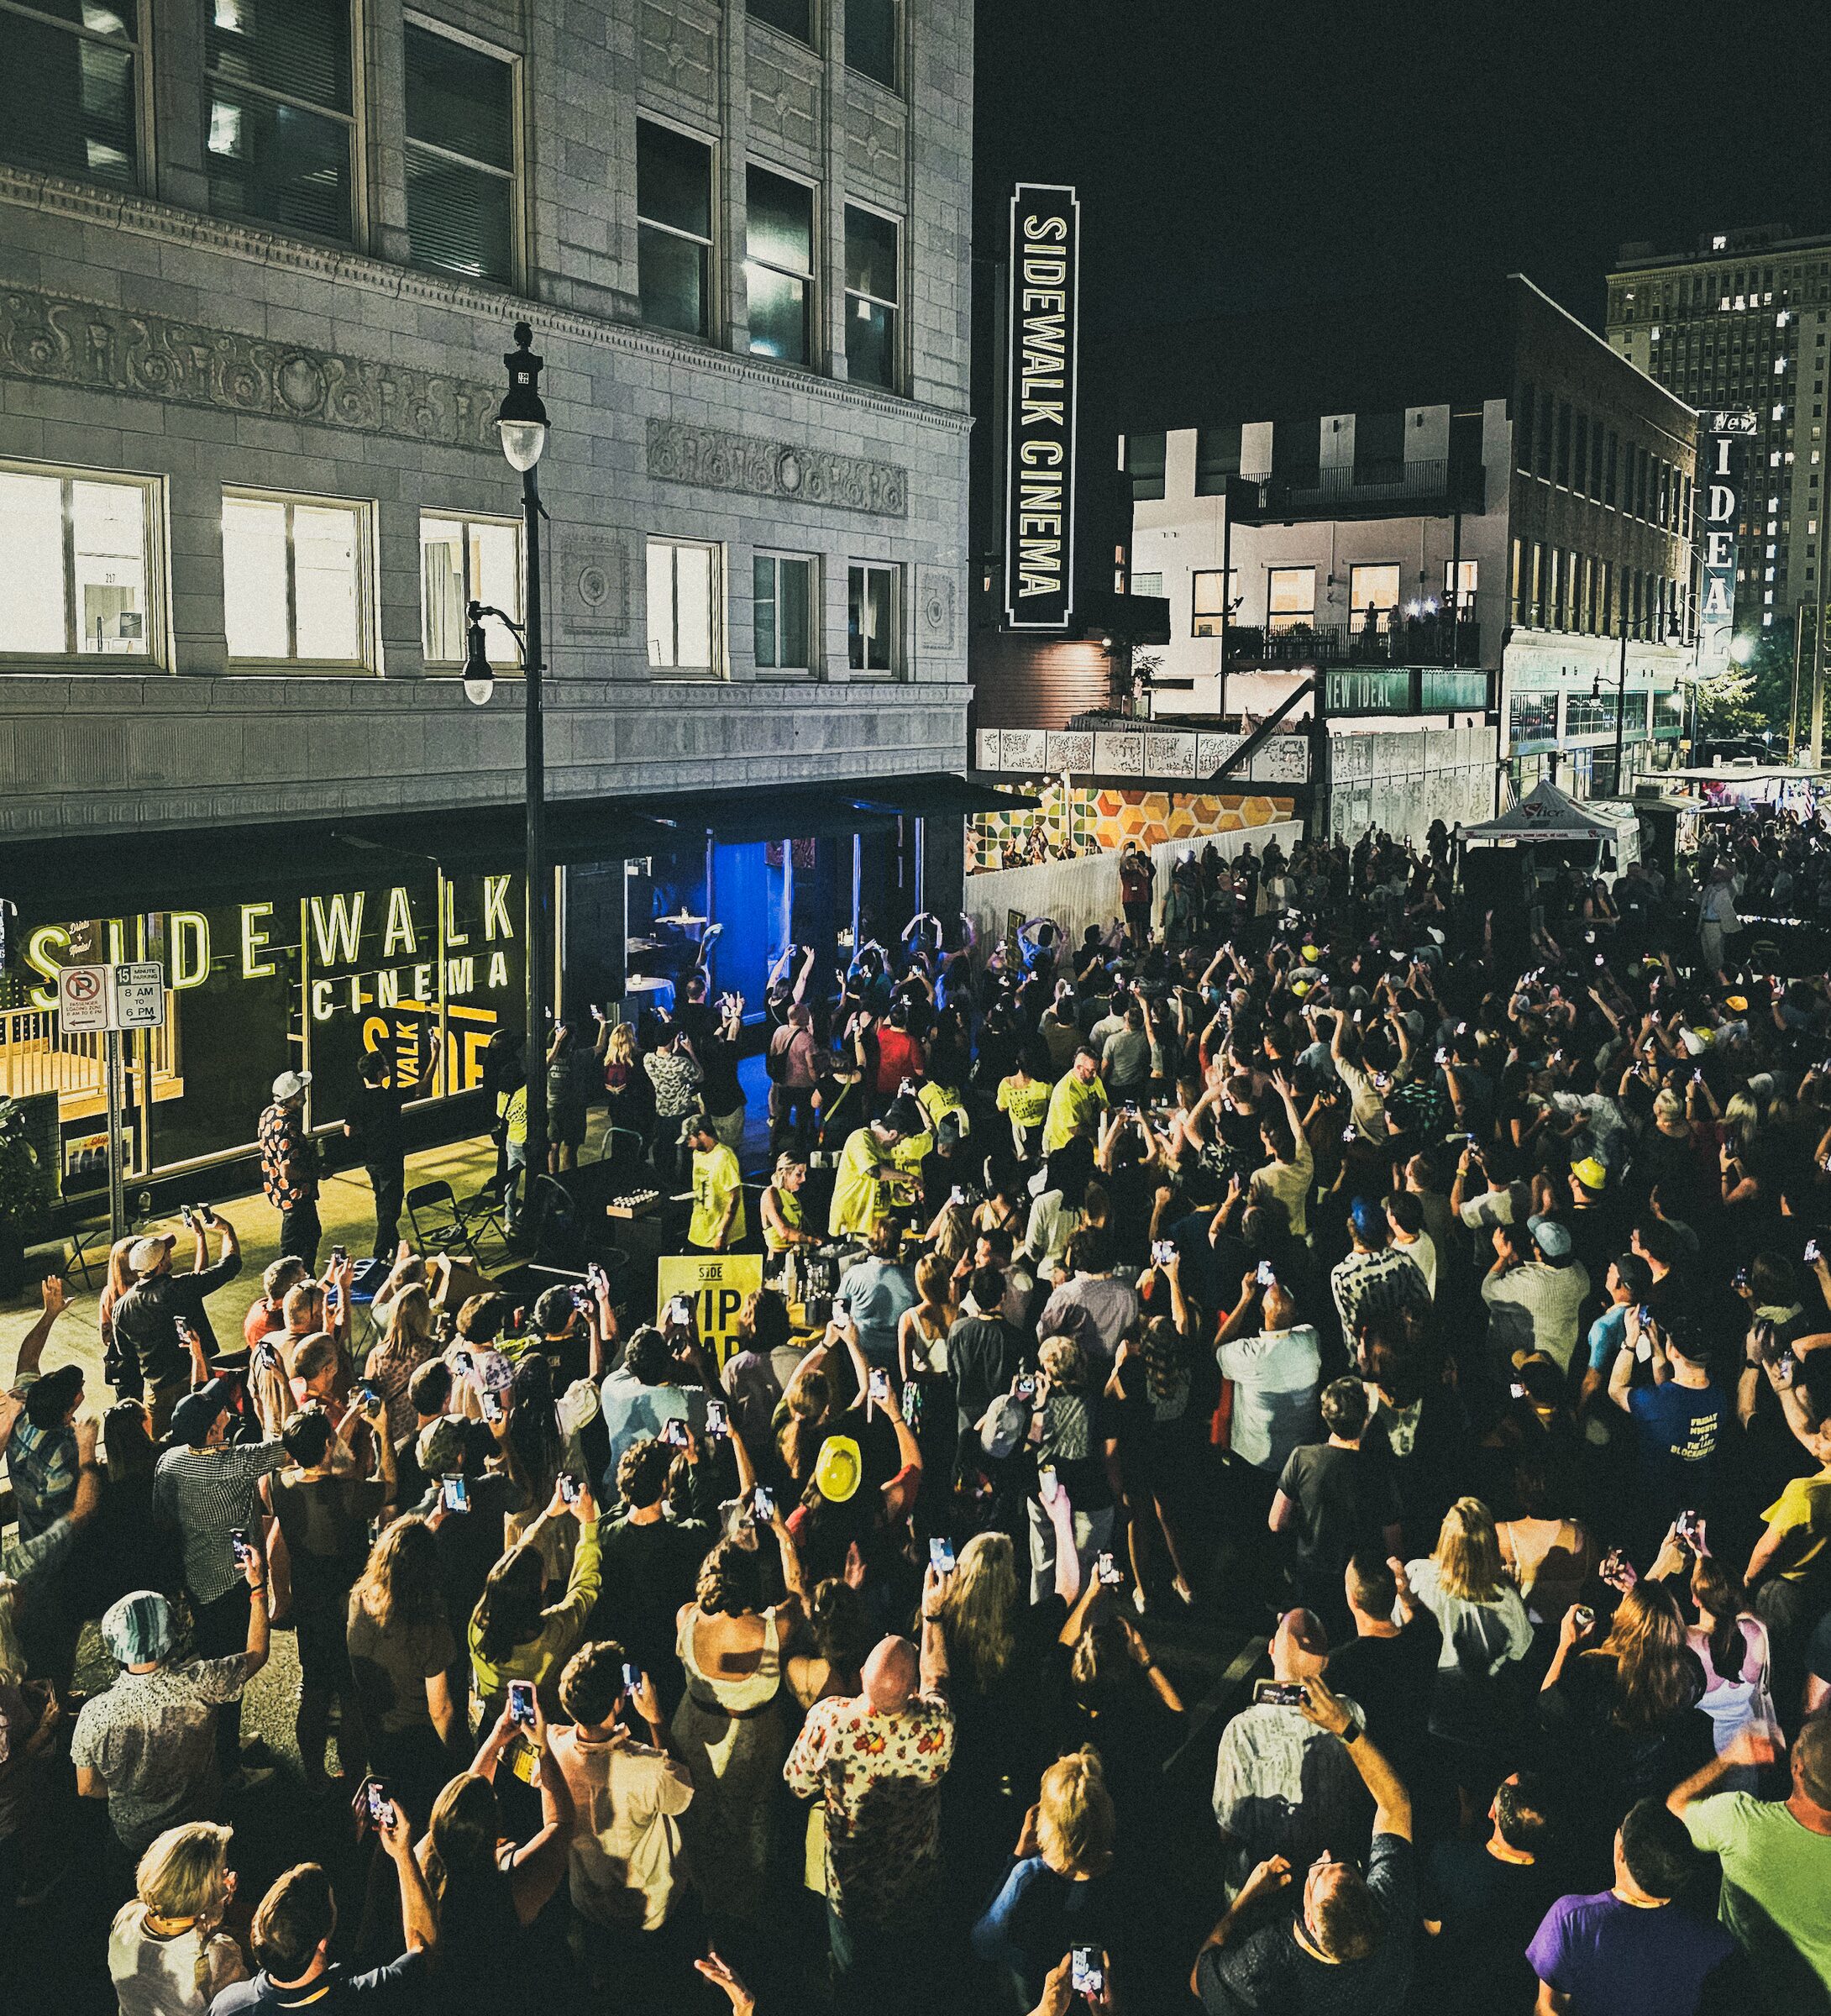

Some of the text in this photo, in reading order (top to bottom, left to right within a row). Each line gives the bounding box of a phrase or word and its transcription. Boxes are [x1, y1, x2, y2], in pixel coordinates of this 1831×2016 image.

[1019, 215, 1068, 598] SIDEWALK CINEMA
[1699, 439, 1736, 661] IDEAL
[105, 573, 116, 583] 217
[1325, 675, 1391, 709] NEW IDEAL
[118, 968, 130, 983] 15
[124, 987, 154, 997] 8 AM
[312, 951, 508, 1021] CINEMA
[126, 1007, 155, 1016] 6 PM
[1691, 1412, 1718, 1426] FRIDAY
[1687, 1438, 1714, 1450] THE LAST
